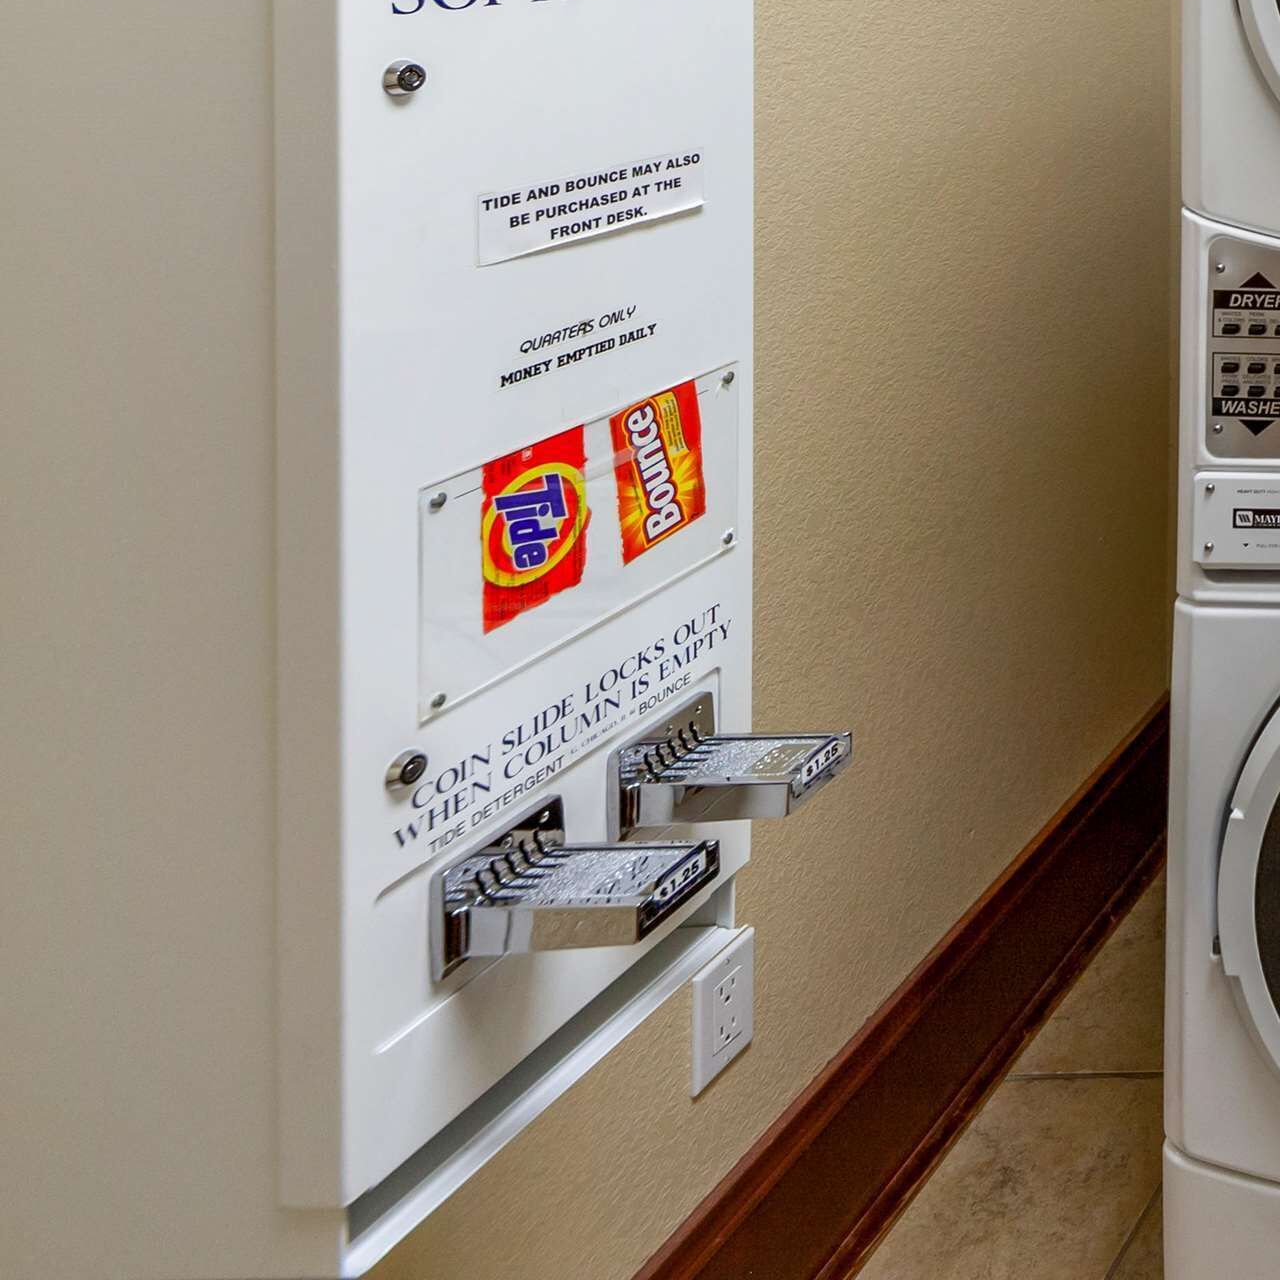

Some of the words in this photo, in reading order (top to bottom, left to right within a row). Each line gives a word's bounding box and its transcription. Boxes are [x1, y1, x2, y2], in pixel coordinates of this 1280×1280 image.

[482, 193, 522, 212] TIDE
[526, 185, 561, 203] AND
[565, 169, 628, 193] BOUNCE
[632, 161, 662, 178] MAY
[665, 153, 701, 170] ALSO
[509, 215, 530, 228] BE
[535, 190, 628, 222] PURCHASED
[631, 185, 650, 198] AT
[654, 177, 682, 194] THE
[550, 218, 602, 240] FRONT
[606, 206, 648, 225] DESK.
[500, 359, 553, 388] MONEY
[556, 338, 616, 368] EMPTIED
[618, 323, 657, 346] DAILY
[519, 319, 594, 354] QUARTERS
[599, 305, 637, 329] ONLY
[628, 404, 682, 540] Bounce
[493, 472, 569, 571] Tide
[412, 744, 492, 809] COIN
[502, 693, 574, 755] SLIDE
[585, 638, 665, 704] LOCKS
[673, 603, 721, 646] OUT
[638, 672, 692, 716] BOUNCE
[393, 771, 493, 848] WHEN
[503, 689, 622, 779] COLUMN
[631, 672, 650, 700] IS
[659, 619, 732, 682] EMPTY
[427, 820, 466, 854] TIDE
[471, 754, 566, 827] DETERGENT
[659, 859, 699, 898] $1.25
